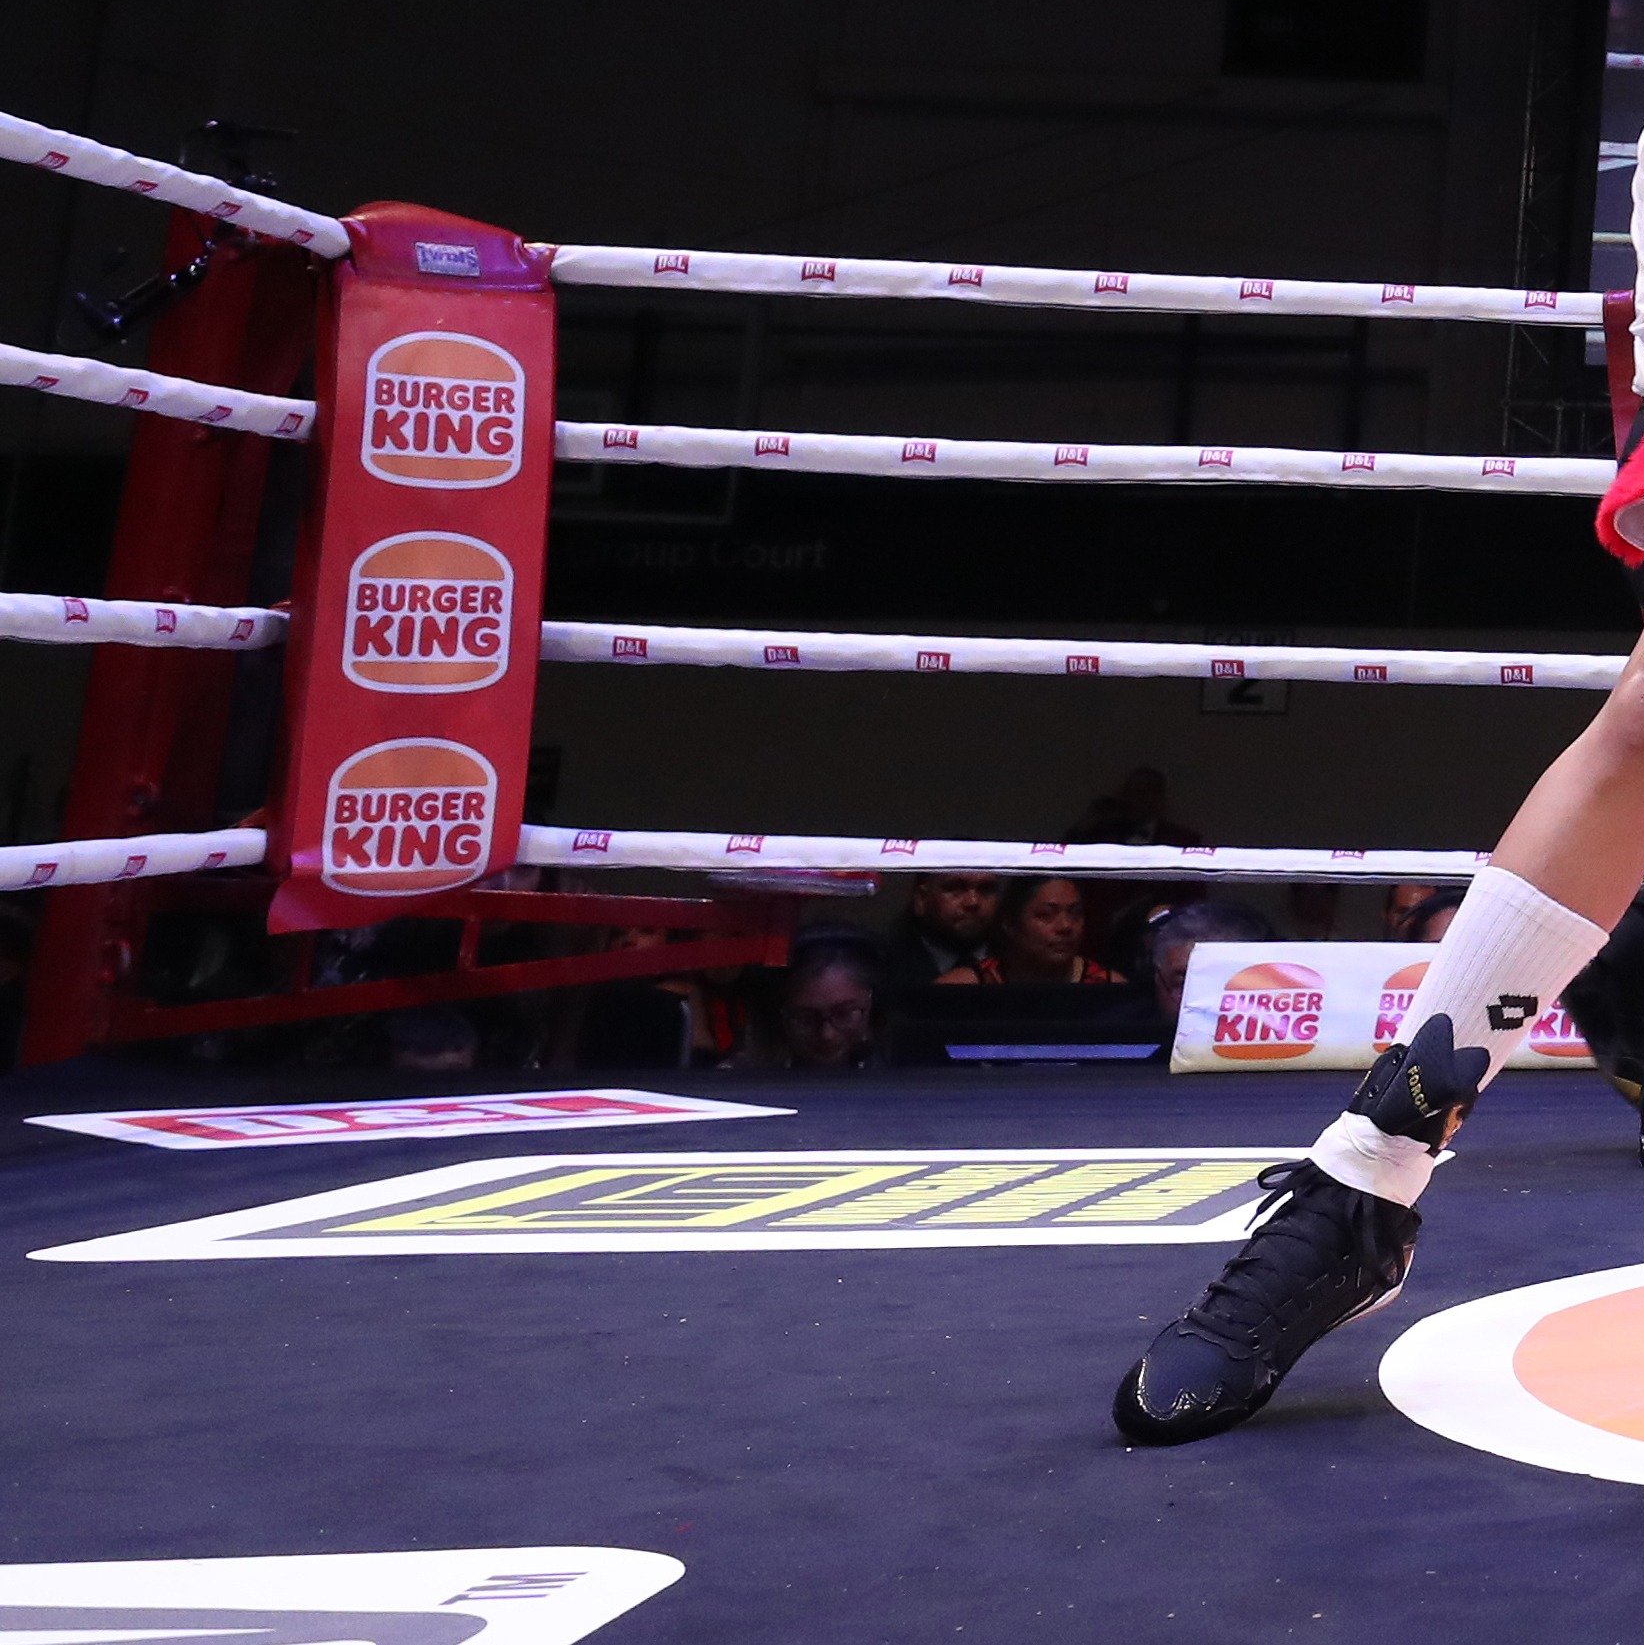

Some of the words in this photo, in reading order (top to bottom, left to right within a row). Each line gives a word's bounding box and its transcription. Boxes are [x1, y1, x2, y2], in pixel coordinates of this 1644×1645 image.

[375, 378, 516, 414] BURGER
[371, 408, 514, 455] KING
[356, 583, 503, 614] BURGER
[353, 615, 501, 657] KING
[334, 792, 486, 823] BURGER
[332, 823, 482, 868] KING
[1219, 992, 1324, 1013] BURGER
[1213, 1013, 1321, 1042] KING
[179, 1102, 637, 1135] D&L
